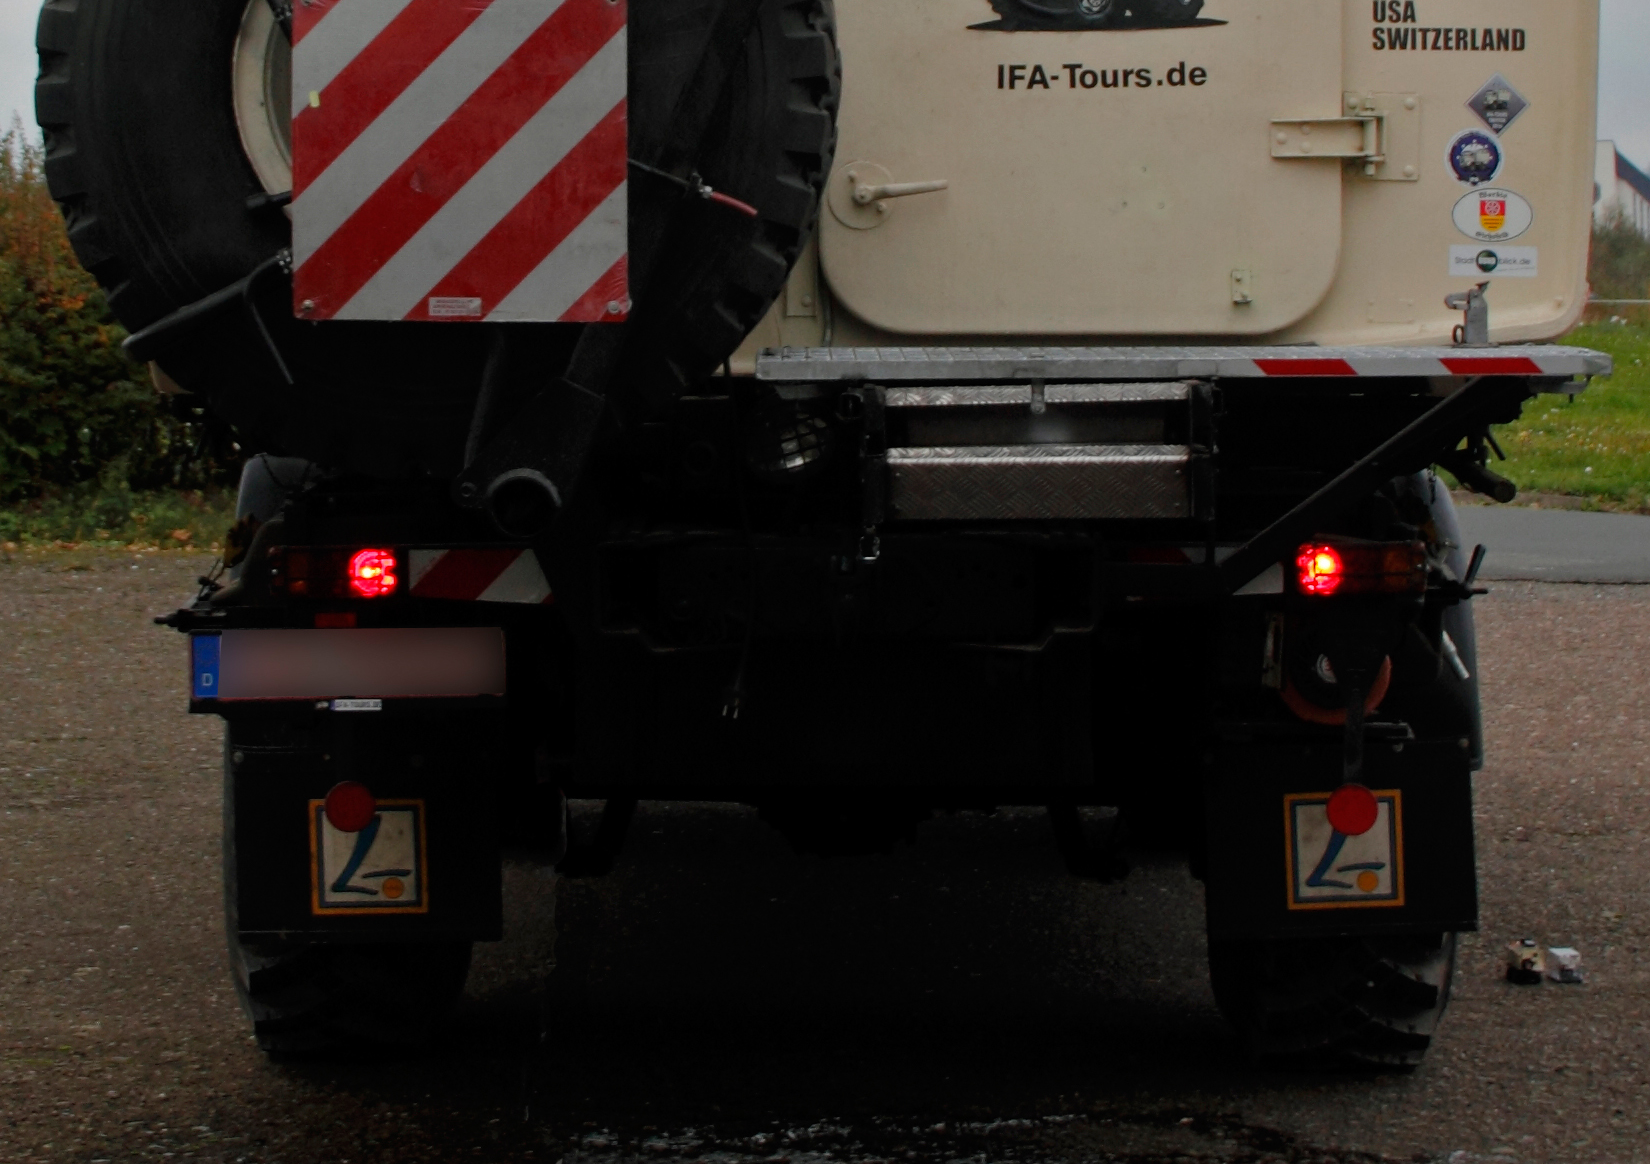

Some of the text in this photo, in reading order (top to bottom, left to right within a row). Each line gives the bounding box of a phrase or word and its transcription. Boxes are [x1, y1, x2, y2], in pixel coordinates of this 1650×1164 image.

[1373, 0, 1417, 23] USA
[1373, 27, 1526, 51] SWITZERLAND
[997, 61, 1207, 90] IFA-Tours.de
[201, 672, 213, 686] D
